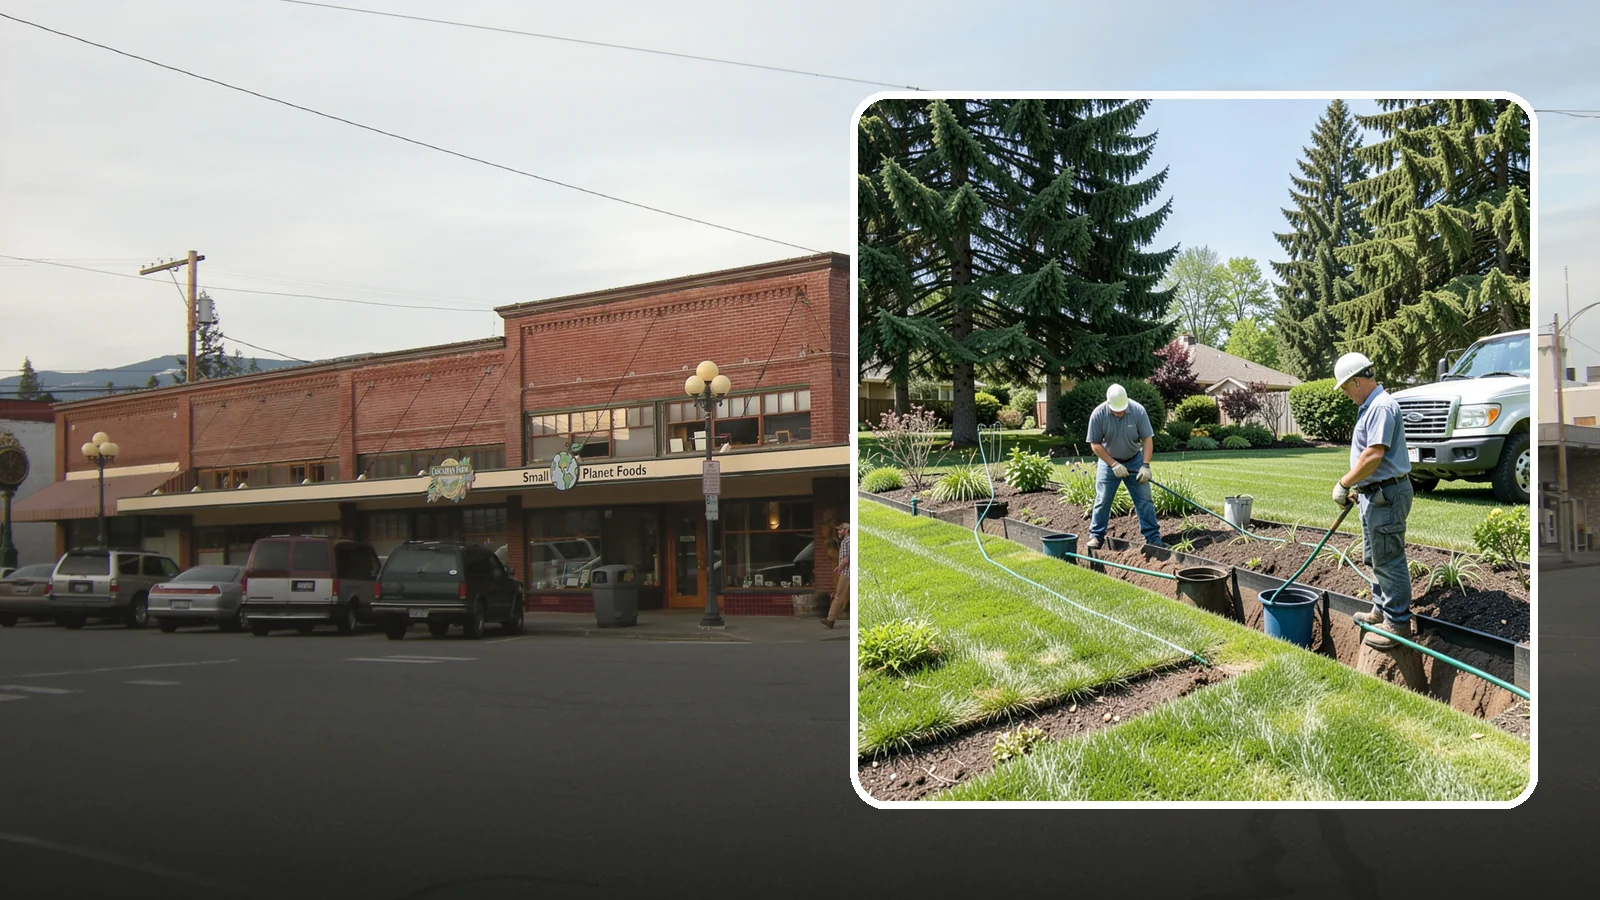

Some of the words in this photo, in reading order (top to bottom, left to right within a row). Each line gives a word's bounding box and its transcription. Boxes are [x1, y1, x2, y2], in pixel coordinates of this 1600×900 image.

[456, 465, 469, 474] FARM
[523, 471, 549, 482] Small
[583, 468, 614, 479] Planet
[617, 464, 647, 477] Foods
